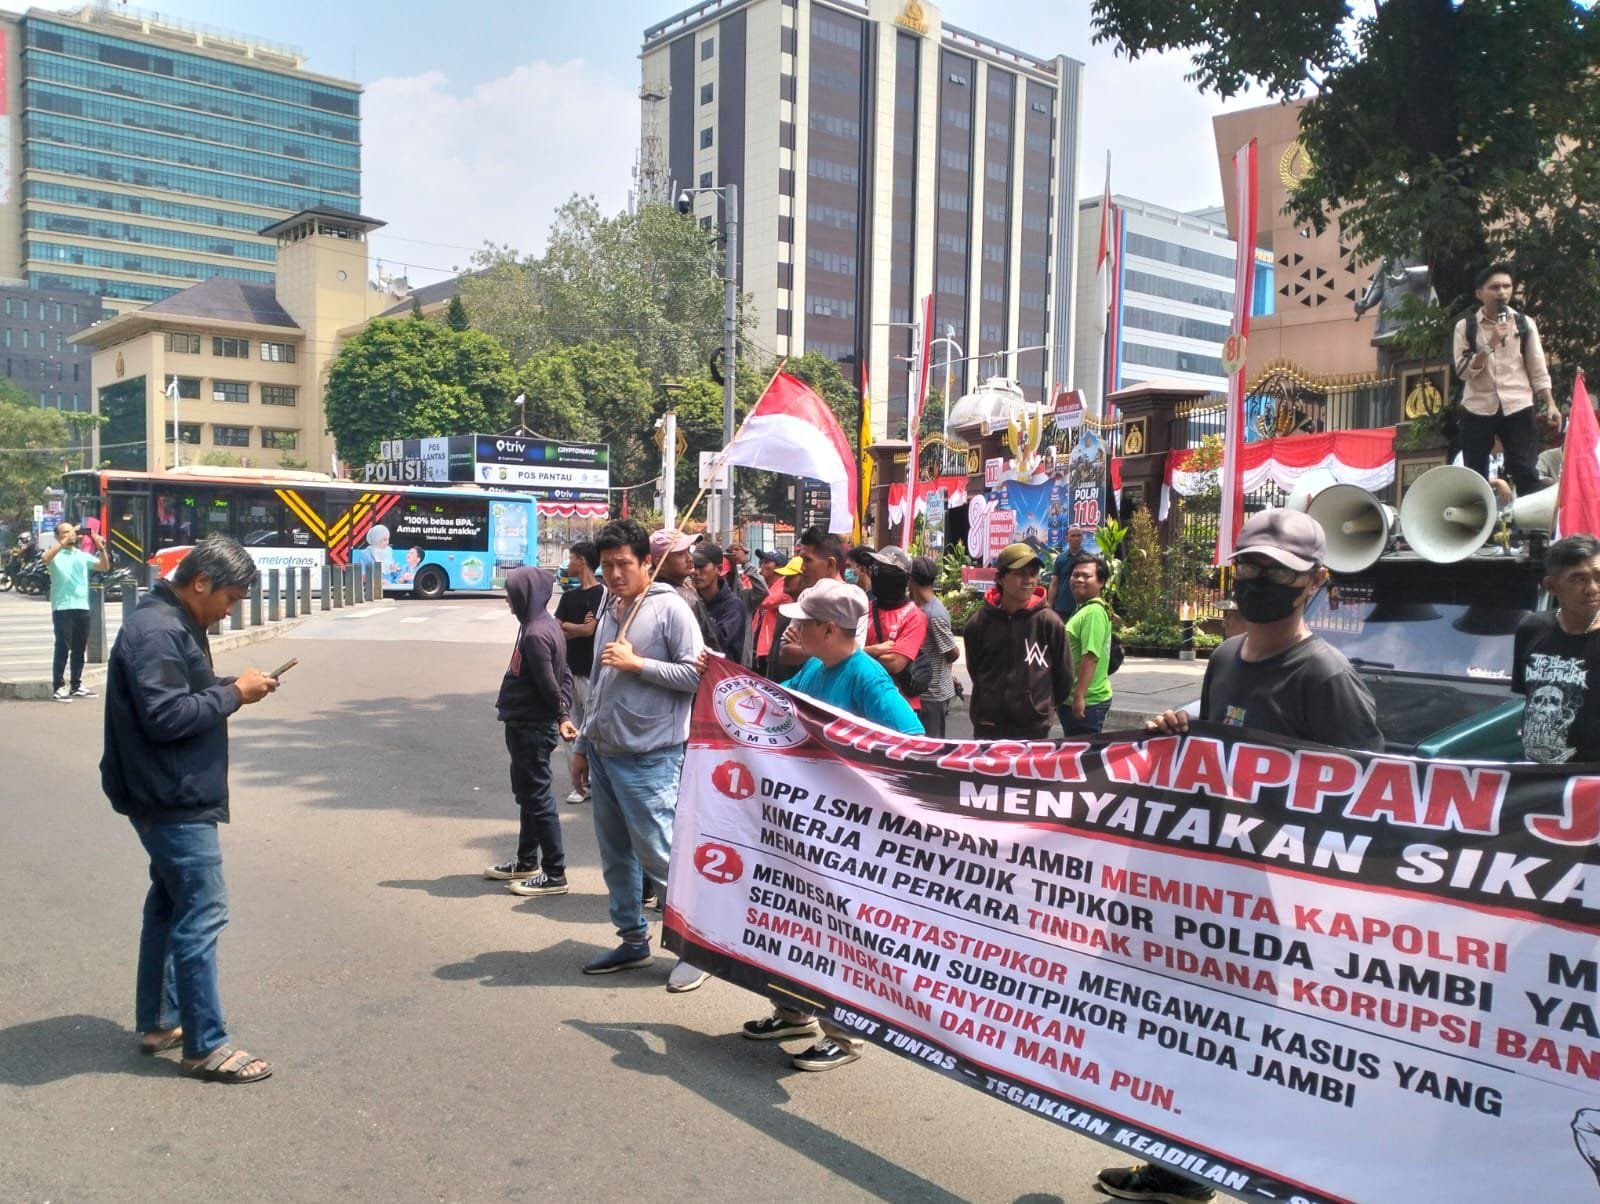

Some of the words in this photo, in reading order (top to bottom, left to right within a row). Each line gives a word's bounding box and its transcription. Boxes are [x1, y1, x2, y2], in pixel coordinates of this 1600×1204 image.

[1226, 335, 1242, 362] 81
[365, 461, 420, 482] POLISI
[518, 471, 536, 480] POS
[538, 473, 572, 481] PANTAU
[1075, 488, 1099, 500] POLRI
[430, 518, 454, 526] bebas
[1073, 499, 1100, 526] 110
[397, 525, 421, 533] Aman
[422, 526, 447, 535] untuk
[719, 681, 740, 694] DPP
[726, 722, 793, 745] JAMBI
[727, 768, 749, 796] 1.
[937, 741, 1092, 783] LSM
[1101, 736, 1510, 836] MAPPAN
[959, 780, 1372, 874] MENYATAKAN
[1397, 843, 1600, 910] SIKA
[702, 848, 734, 880] 2.
[761, 777, 809, 804] DPP
[813, 794, 873, 825] LSM
[878, 811, 998, 859] MAPPAN
[1006, 843, 1093, 883] JAMBI
[1101, 865, 1280, 925] MEMINTA
[1294, 905, 1508, 973] KAPOLRI
[761, 803, 860, 851] KINERJA
[876, 839, 1016, 895] PENYIDIK
[1031, 878, 1154, 933] TIPIKOR
[1174, 915, 1314, 970] POLDA
[1334, 952, 1493, 1013] JAMBI
[760, 828, 887, 885] MENANGANI
[892, 871, 1019, 924] PERKARA
[1027, 909, 1132, 957] TINDAK
[1143, 940, 1278, 996] PIDANA
[1292, 977, 1482, 1048] KORUPSI
[746, 907, 821, 948] SAMPAI
[827, 934, 908, 985] TINGKAT
[913, 974, 1086, 1050] PENYIDIKAN
[752, 863, 852, 916] MENDESAK
[856, 903, 1068, 985] KORTASTIPIKOR
[1078, 970, 1250, 1042] MENGAWAL
[1261, 1024, 1380, 1080] KASUS
[1393, 1061, 1503, 1118] YANG
[749, 887, 822, 925] SEDANG
[827, 916, 941, 972] DITANGANI
[946, 959, 1127, 1034] SUBDITPIKOR
[1137, 1018, 1238, 1071] POLDA
[1247, 1054, 1356, 1108] JAMBI
[742, 928, 782, 956] DAN
[788, 945, 836, 977] DARI
[841, 964, 934, 1022] TEKANAN
[939, 1010, 1006, 1050] DARI
[1013, 1036, 1101, 1085] MANA
[1109, 1070, 1182, 1115] PUN.
[833, 1006, 881, 1035] USUT
[884, 1028, 958, 1071] TUNTAS
[984, 1076, 1110, 1136] TEGAKKAN
[1113, 1129, 1249, 1192] KEADILAN
